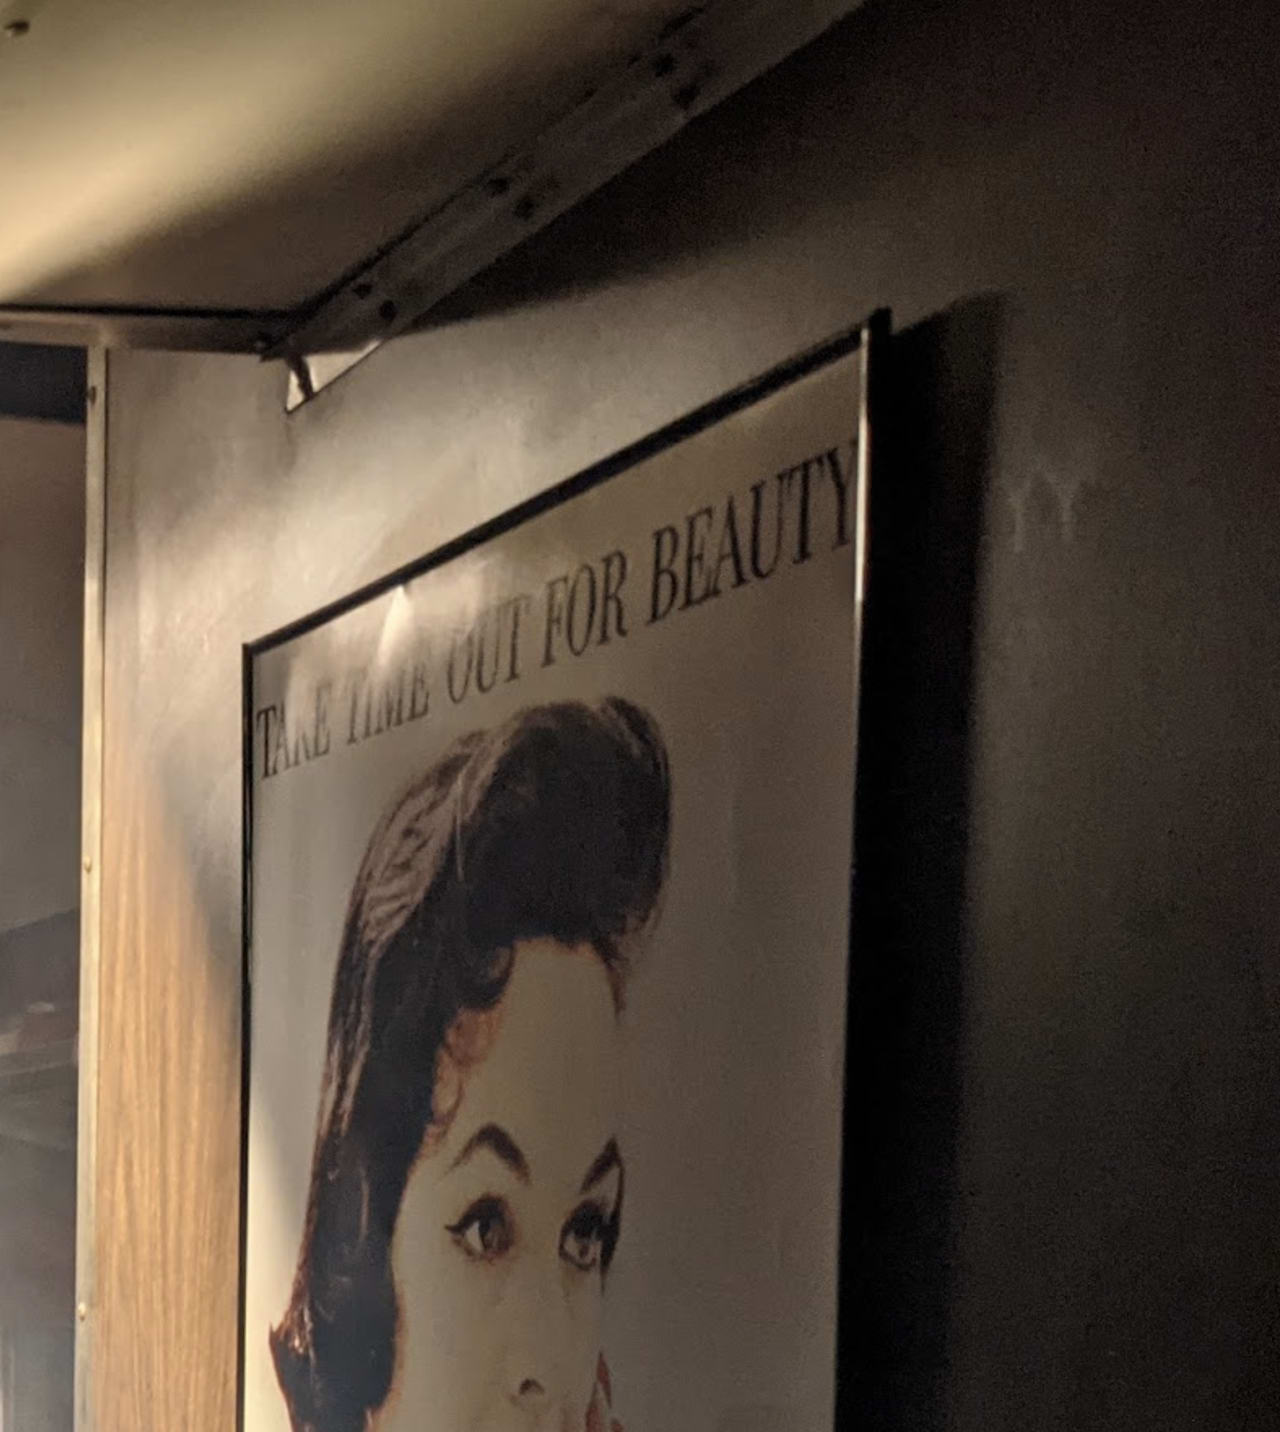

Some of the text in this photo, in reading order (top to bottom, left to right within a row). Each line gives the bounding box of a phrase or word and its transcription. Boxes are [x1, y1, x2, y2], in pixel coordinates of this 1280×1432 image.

[256, 438, 857, 778] TAKE TIME OUT FOR BEAUTY
